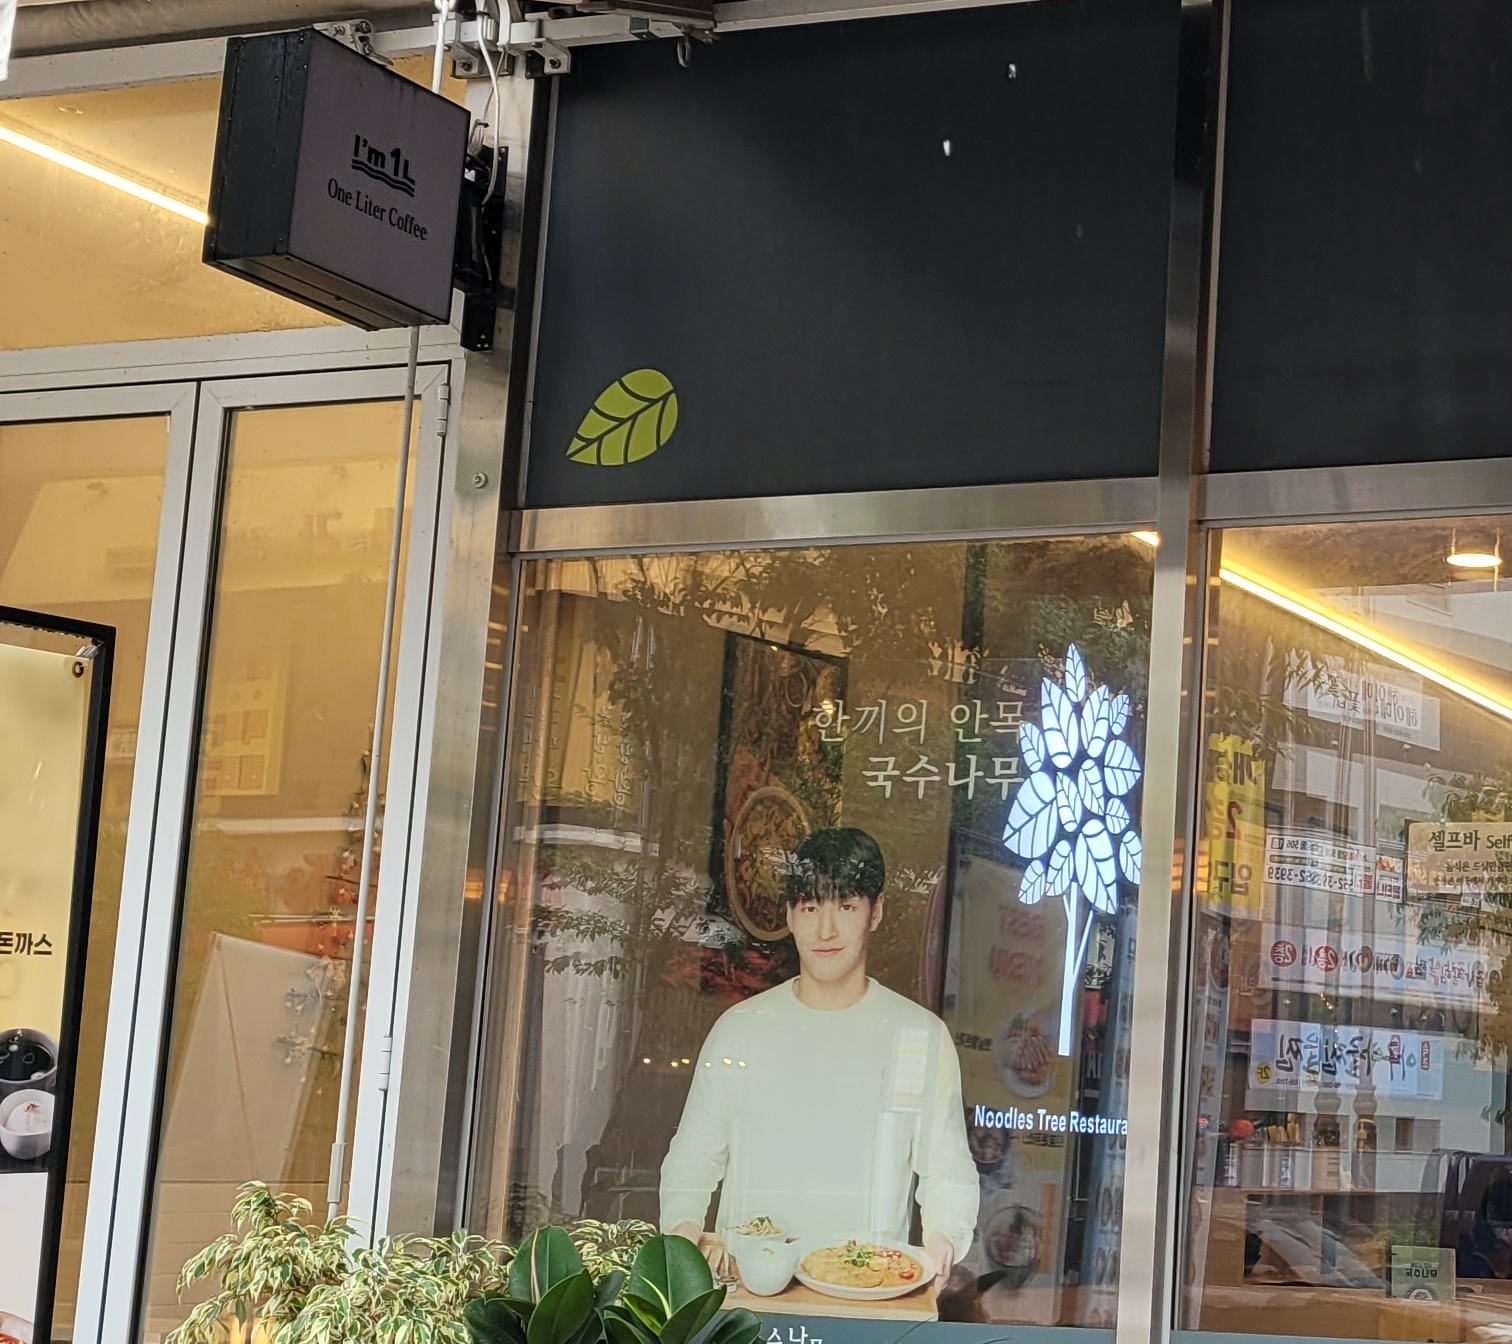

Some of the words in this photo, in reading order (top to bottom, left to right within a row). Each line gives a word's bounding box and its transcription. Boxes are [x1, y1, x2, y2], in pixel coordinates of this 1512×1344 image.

[353, 134, 386, 169] I'm
[328, 178, 353, 206] One
[355, 190, 387, 222] Liter
[388, 207, 428, 241] Coffee
[811, 699, 928, 745] 한끼의
[950, 699, 1027, 745] 안목
[861, 754, 1026, 801] 국수나무
[1429, 829, 1481, 852] 셀프바
[1486, 834, 1512, 849] Self
[0, 931, 53, 956] 돈까스
[974, 1104, 1034, 1131] Noodles
[1036, 1108, 1067, 1133] Tree
